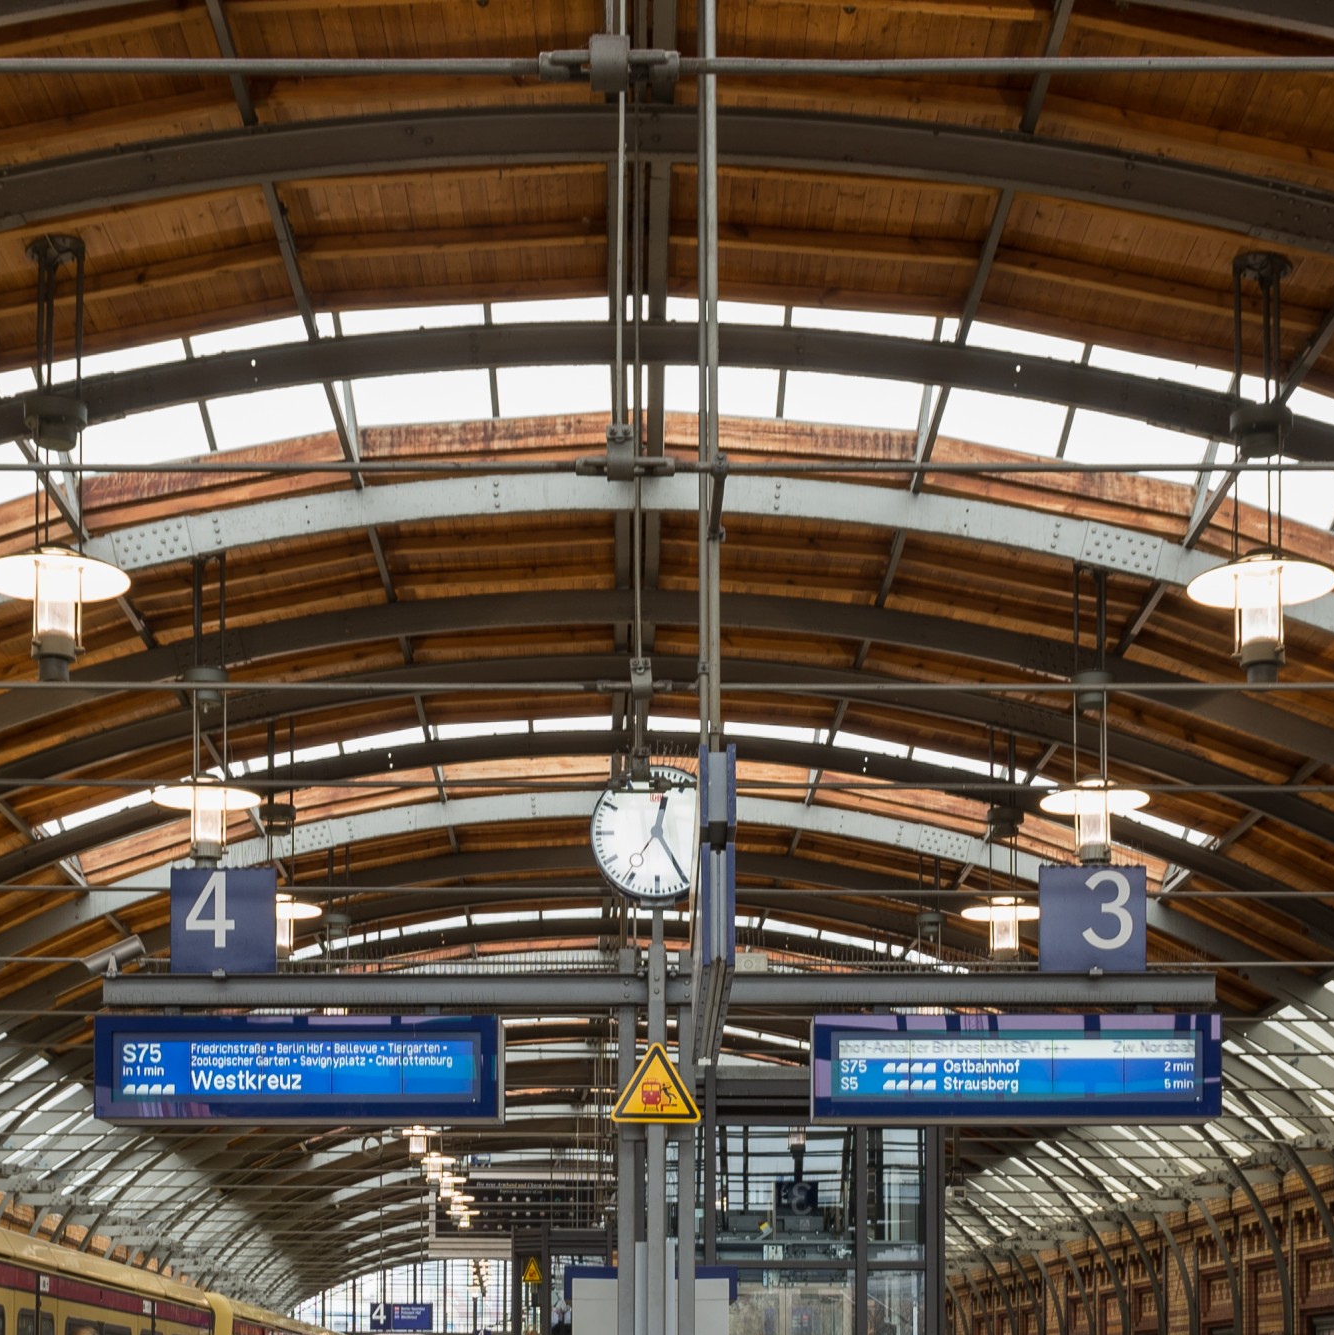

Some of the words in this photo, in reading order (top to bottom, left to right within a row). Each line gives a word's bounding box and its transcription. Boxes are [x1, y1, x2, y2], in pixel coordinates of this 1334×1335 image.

[186, 871, 235, 948] 4
[1082, 870, 1133, 950] 3
[123, 1043, 162, 1063] S75
[191, 1043, 267, 1054] Friedrichstraße
[277, 1043, 305, 1053] Berlin
[307, 1043, 324, 1053] Hbf
[334, 1043, 377, 1053] Bellevue
[388, 1043, 441, 1056] Tiergarten
[123, 1065, 133, 1076] in
[136, 1065, 141, 1076] 1
[144, 1065, 165, 1076] min
[191, 1055, 253, 1069] Zoologischer
[256, 1056, 290, 1066] Garten
[300, 1055, 366, 1069] Savignyplatz
[375, 1055, 453, 1068] Charlottenburg
[841, 1059, 867, 1073] S75
[943, 1059, 1020, 1073] Ostbahnhof
[1164, 1061, 1171, 1072] 2
[1173, 1060, 1194, 1072] min
[191, 1070, 302, 1091] Westkreuz
[841, 1076, 859, 1090] S5
[943, 1076, 1019, 1093] Strausberg
[1173, 1078, 1194, 1089] min
[372, 1304, 386, 1325] 4
